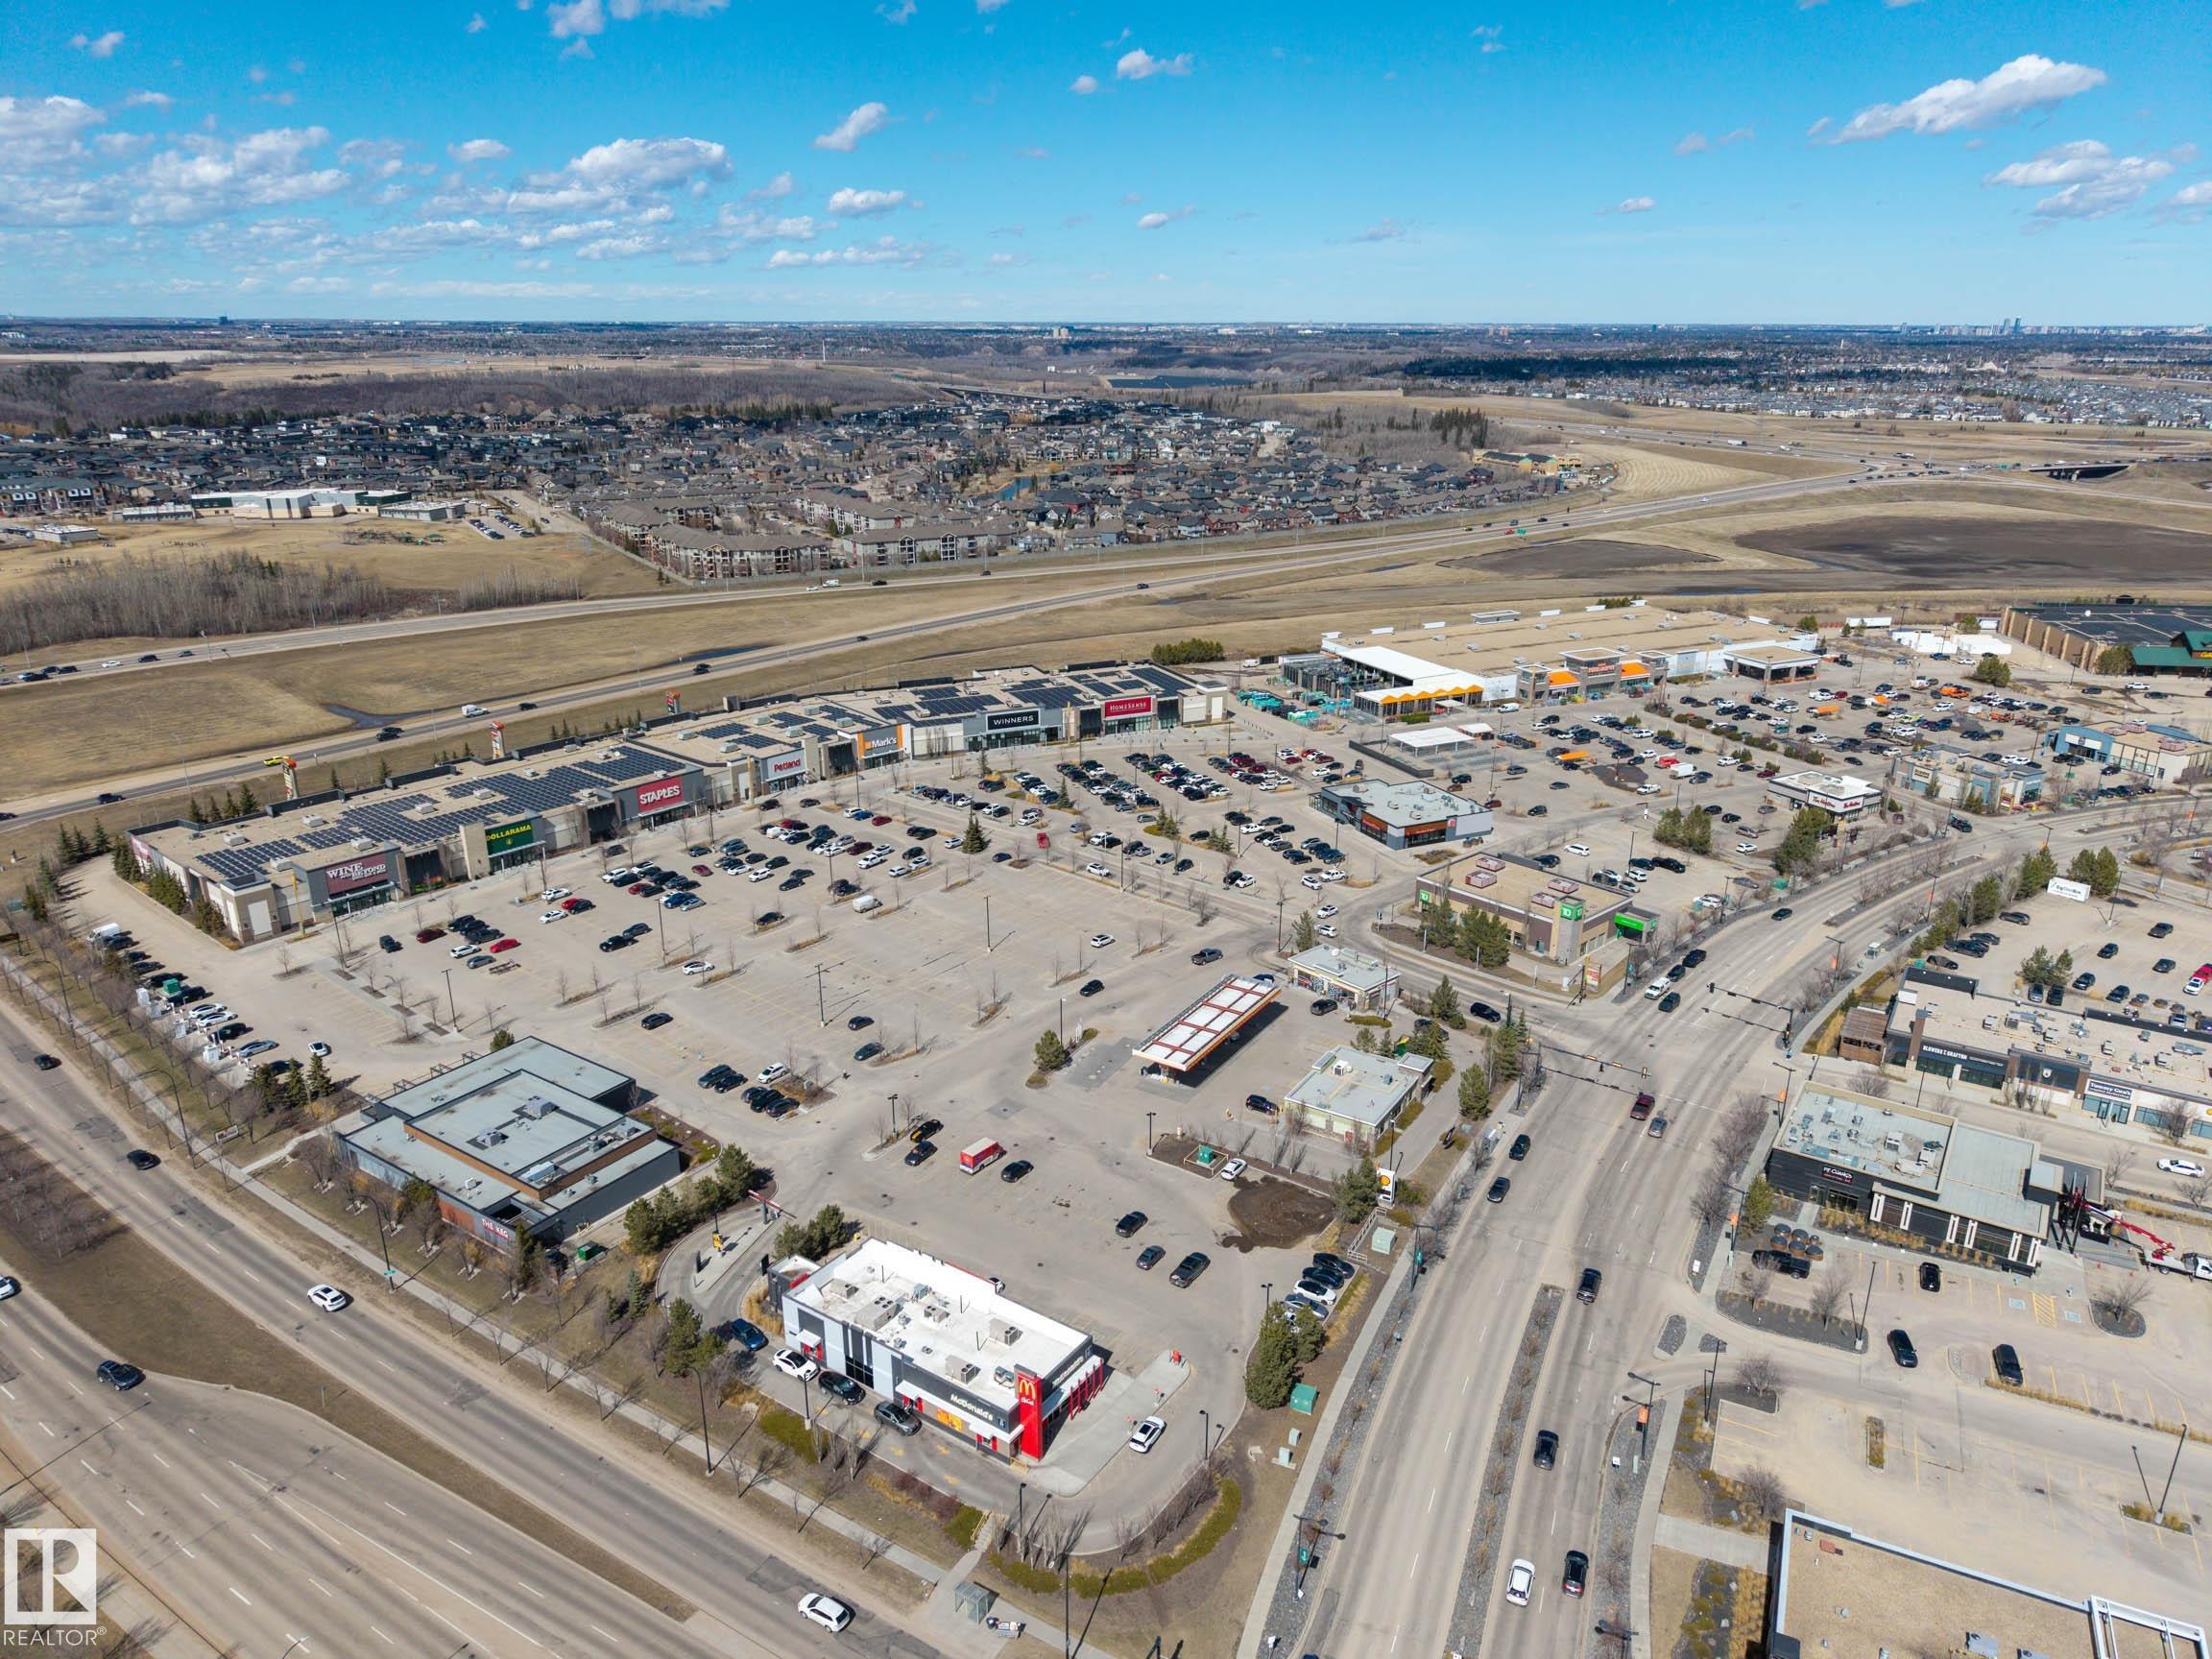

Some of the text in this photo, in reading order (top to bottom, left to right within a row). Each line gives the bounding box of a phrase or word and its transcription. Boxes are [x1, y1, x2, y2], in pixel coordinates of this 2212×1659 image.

[993, 714, 1035, 726] WINNERS
[872, 736, 898, 748] Mark's
[774, 758, 801, 772] Petland
[639, 785, 681, 805] STAPLES
[486, 825, 532, 841] DOLLARAMA
[326, 862, 362, 879] WINE
[352, 864, 386, 878] BEYOND
[482, 1218, 509, 1238] THE KEG
[950, 1393, 993, 1421] McDonald's
